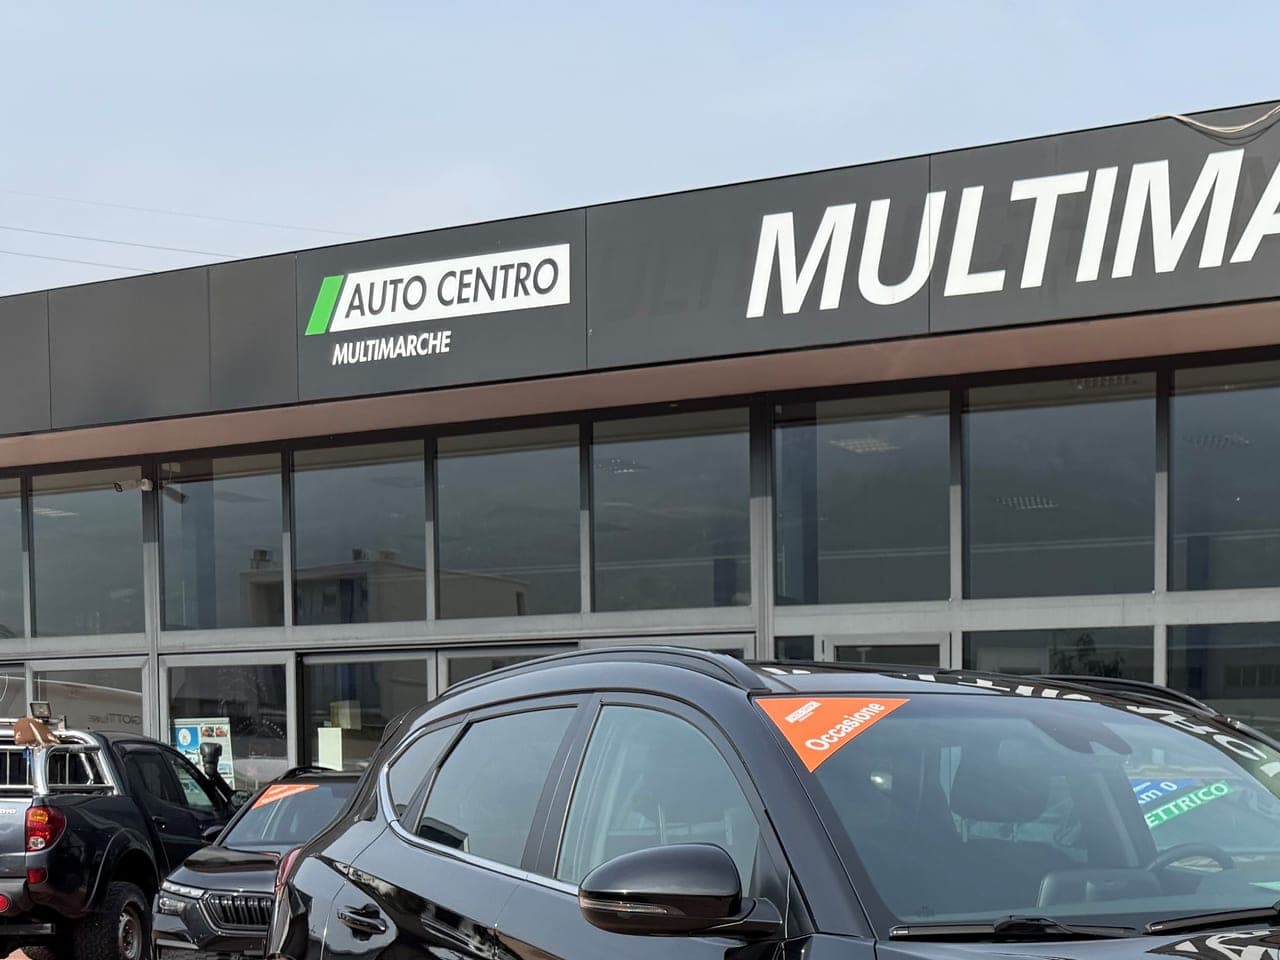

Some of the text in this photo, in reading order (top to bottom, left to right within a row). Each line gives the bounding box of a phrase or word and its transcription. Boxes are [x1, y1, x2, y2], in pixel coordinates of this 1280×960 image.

[344, 275, 427, 319] AUTO
[437, 258, 559, 306] CENTRO
[332, 330, 451, 366] MULTIMARCHE
[805, 702, 886, 751] Occasione
[1138, 789, 1162, 804] m
[1144, 783, 1228, 827] ETTRICO
